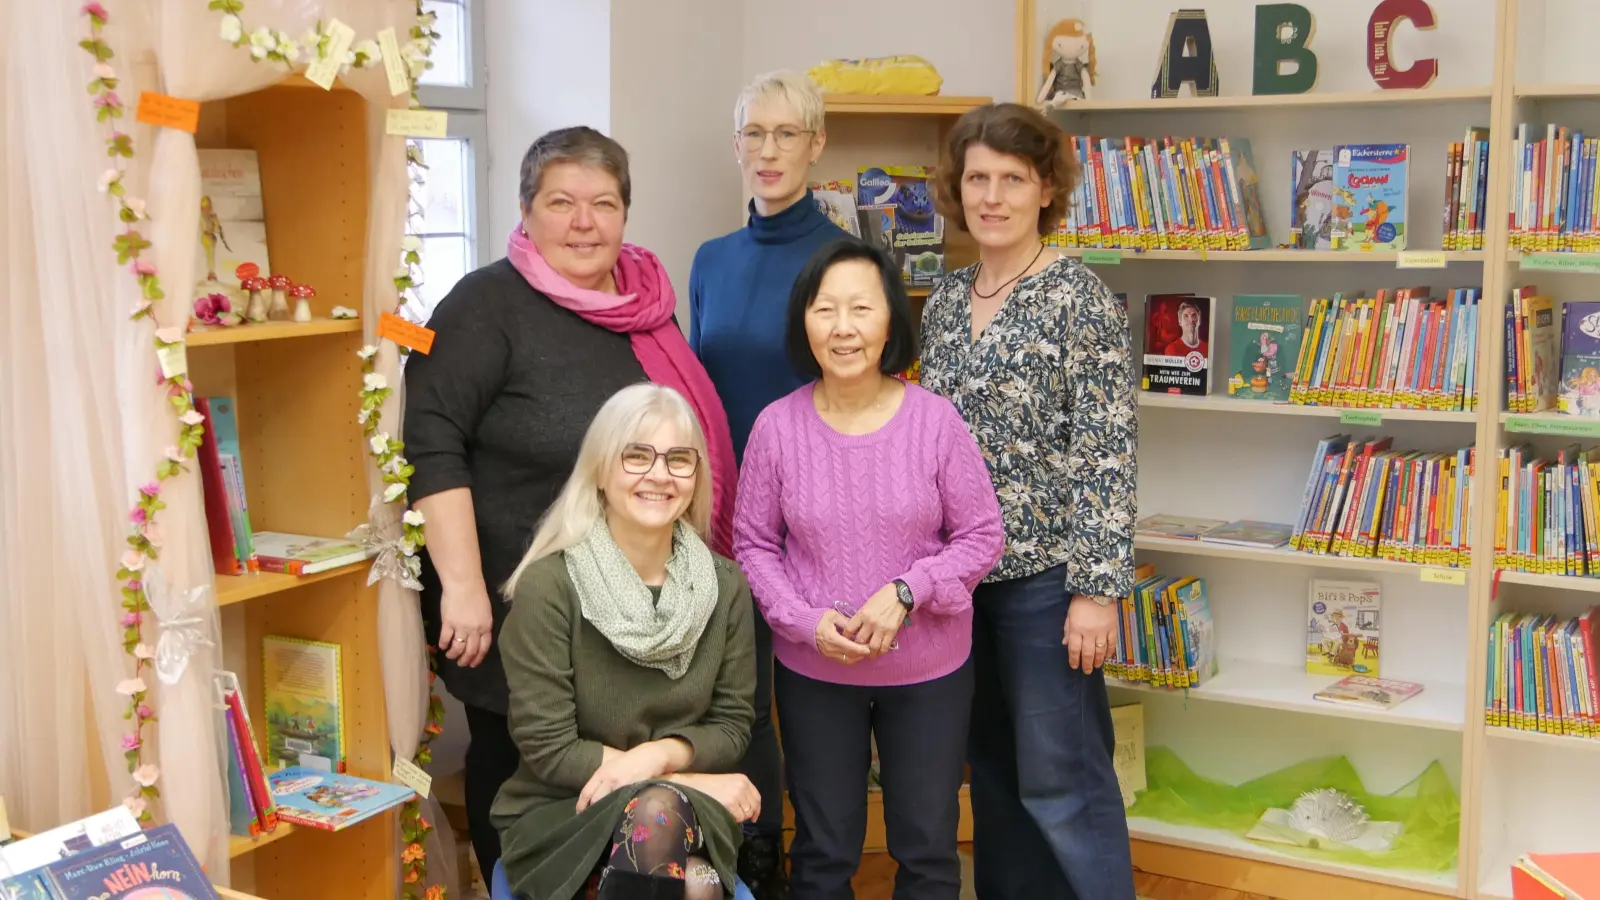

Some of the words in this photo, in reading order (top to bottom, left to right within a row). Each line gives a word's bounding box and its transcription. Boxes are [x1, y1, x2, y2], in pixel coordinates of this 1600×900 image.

[1152, 9, 1219, 98] A
[1253, 3, 1320, 96] B
[1367, 0, 1438, 90] C
[1352, 149, 1393, 157] Büchersterne
[860, 178, 890, 187] Galileo
[1150, 374, 1201, 386] TRAUMVEREIN
[1349, 593, 1373, 605] Pops
[64, 864, 103, 881] Marc-Uwe
[104, 855, 126, 868] Kling
[129, 845, 151, 857] Astrid
[152, 839, 170, 851] Henn
